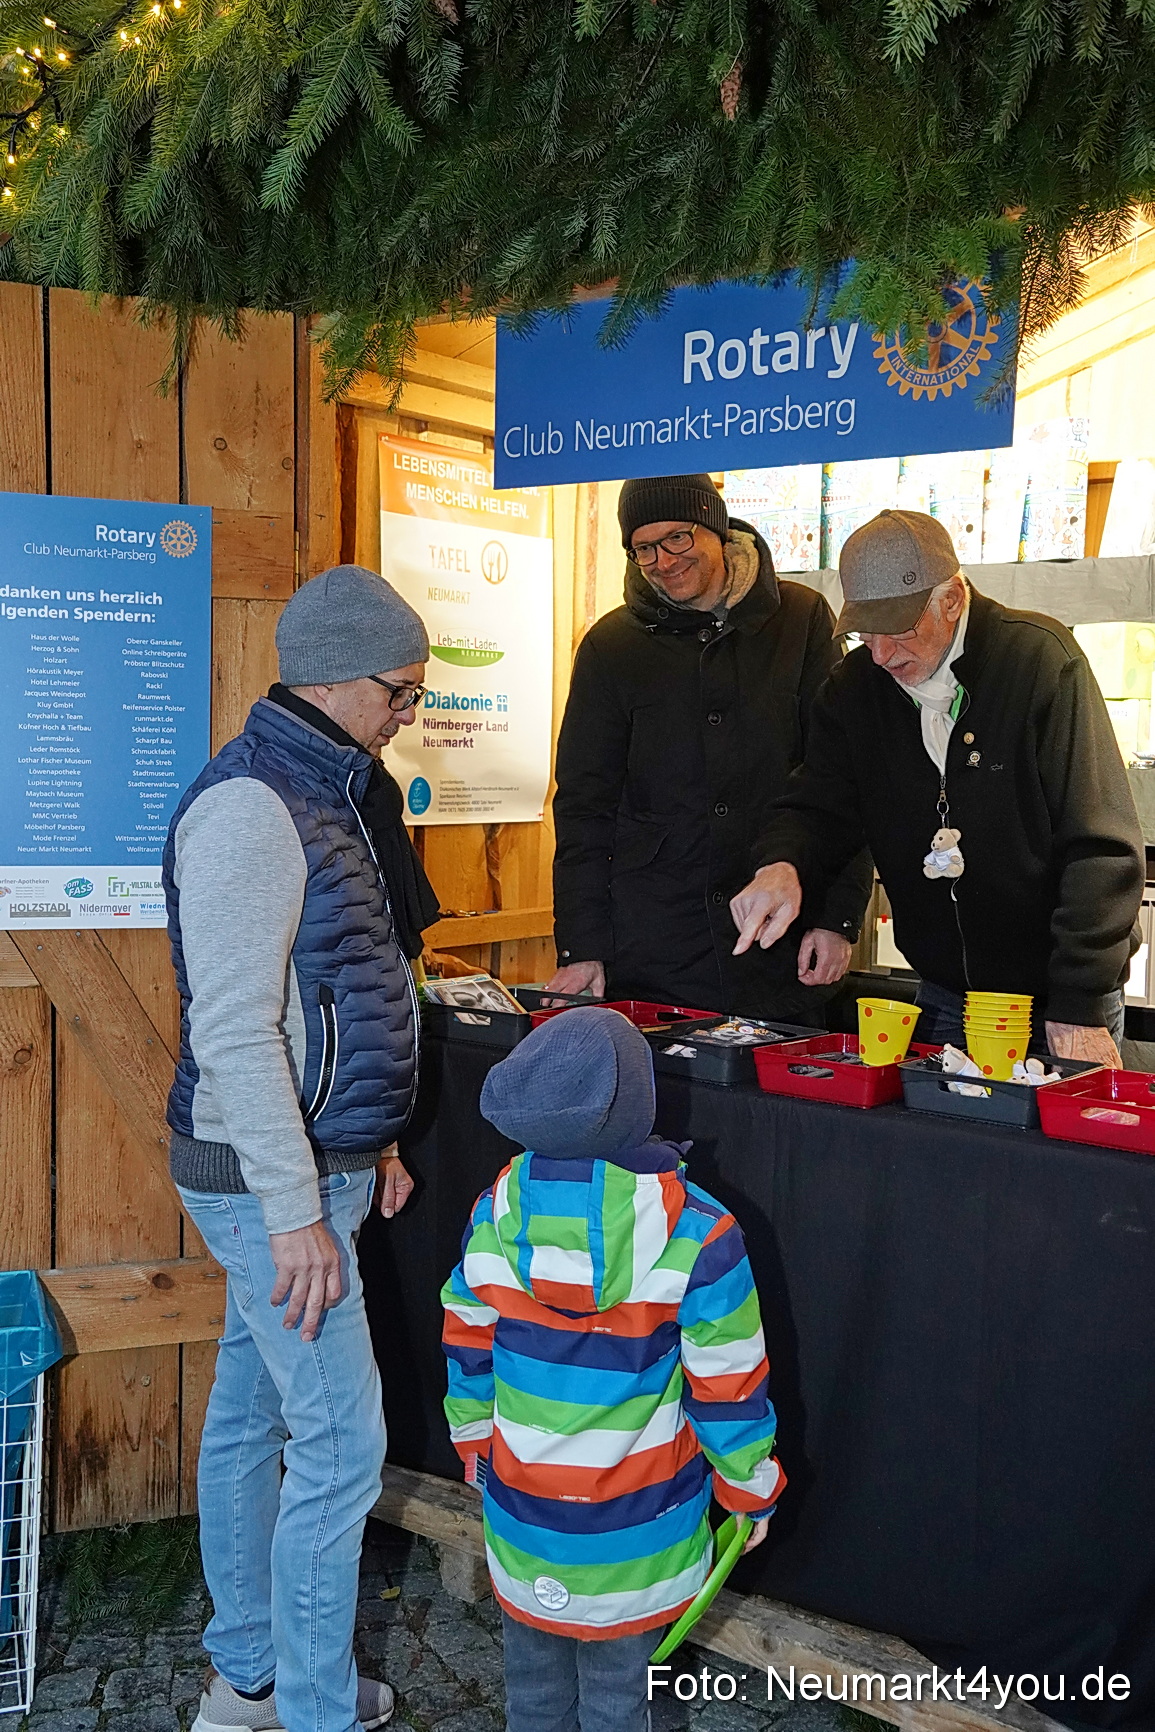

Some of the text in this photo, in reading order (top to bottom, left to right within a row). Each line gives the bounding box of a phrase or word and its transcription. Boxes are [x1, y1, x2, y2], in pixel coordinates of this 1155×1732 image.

[683, 322, 859, 384] Rotary
[891, 346, 980, 386] INTERNATIONAL
[503, 394, 857, 459] Club Neumarkt-Parsberg
[393, 453, 489, 488] LEBENSMITTEL
[406, 482, 478, 510] MENSCHEN
[480, 496, 529, 519] HELFEN.
[95, 524, 157, 548] Rotary
[23, 542, 50, 555] Club
[54, 545, 157, 564] Neumarkt-Parsberg
[428, 544, 471, 573] TAFEL
[0, 585, 163, 606] danken uns herzlich
[427, 587, 471, 605] NEUMARKT
[1, 602, 156, 623] lgenden Spendern:
[437, 633, 498, 651] Leb-mit-Laden
[31, 645, 55, 653] Herzog
[144, 649, 187, 658] Schreibgeräte
[461, 650, 499, 659] NEUMARKT
[151, 660, 185, 668] Blitzschutz
[26, 667, 84, 677] Hörakustik Meyer
[140, 671, 169, 679] Rabovski
[49, 679, 80, 687] Lehmeier
[23, 690, 87, 699] Jacques Weindepot
[37, 701, 52, 709] Kluy
[424, 690, 493, 712] Diakonie
[27, 712, 59, 720] Knychalla
[67, 724, 92, 732] Tiefbau
[422, 717, 509, 734] Nürnberger Land
[135, 737, 159, 745] Scharpf
[422, 736, 474, 749] Neumarkt
[28, 768, 81, 776] Löwenapotheke
[27, 779, 83, 788] Lupine Lightning
[127, 781, 180, 789] Stadtverwaltung
[25, 790, 55, 798] Maybach
[29, 801, 63, 809] Metzgerei
[57, 824, 86, 832] Parsberg
[69, 882, 94, 897] FASS
[112, 881, 126, 893] FT
[10, 902, 70, 912] HOLZSTADL
[80, 903, 132, 914] Nidermayer
